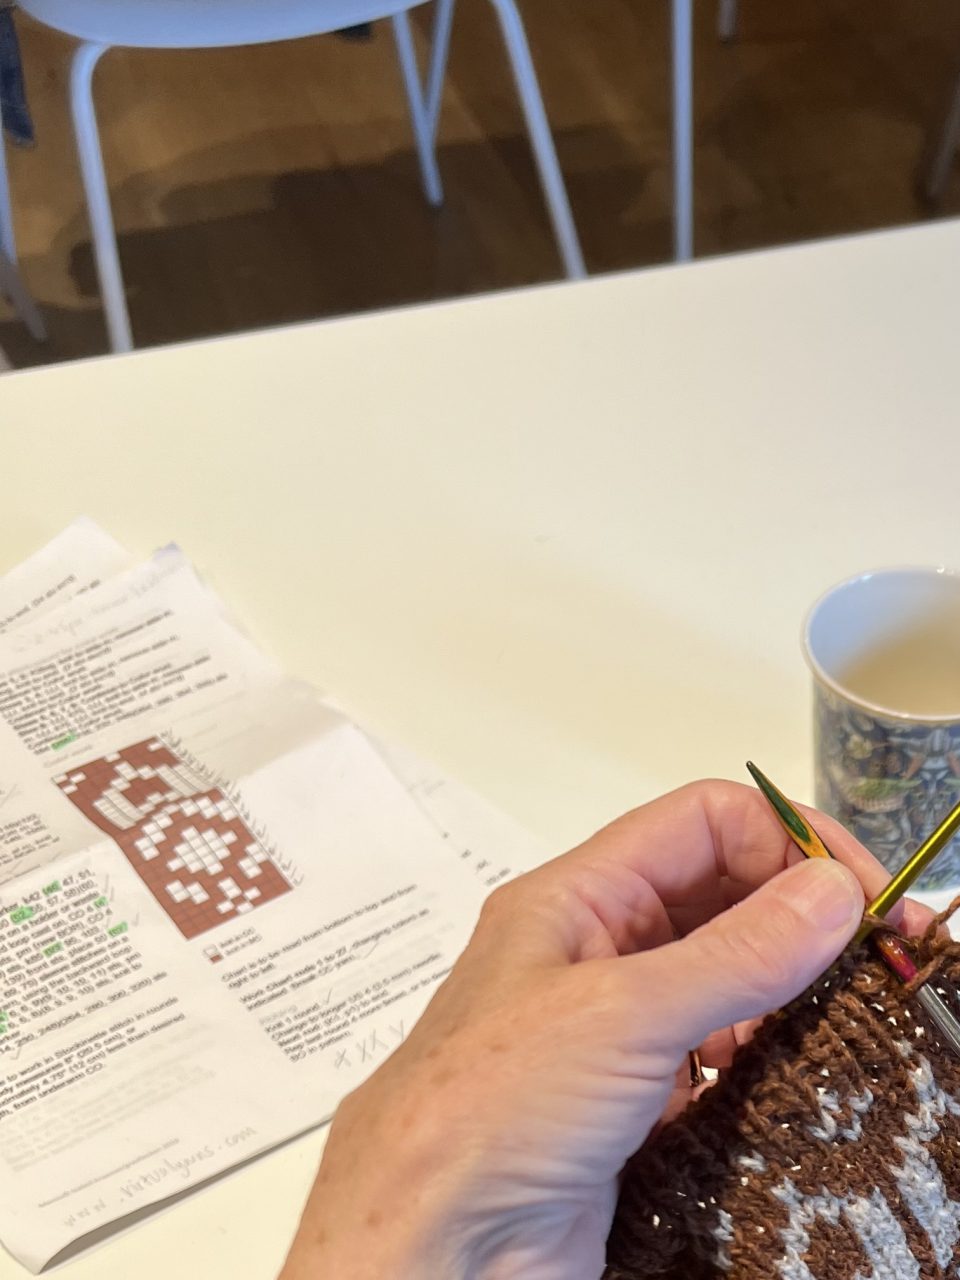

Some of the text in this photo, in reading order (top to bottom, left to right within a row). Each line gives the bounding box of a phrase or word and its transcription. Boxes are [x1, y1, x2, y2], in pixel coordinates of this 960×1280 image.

[30, 910, 57, 925] holder
[324, 914, 355, 932] bottom
[56, 1031, 108, 1058] Stockinette
